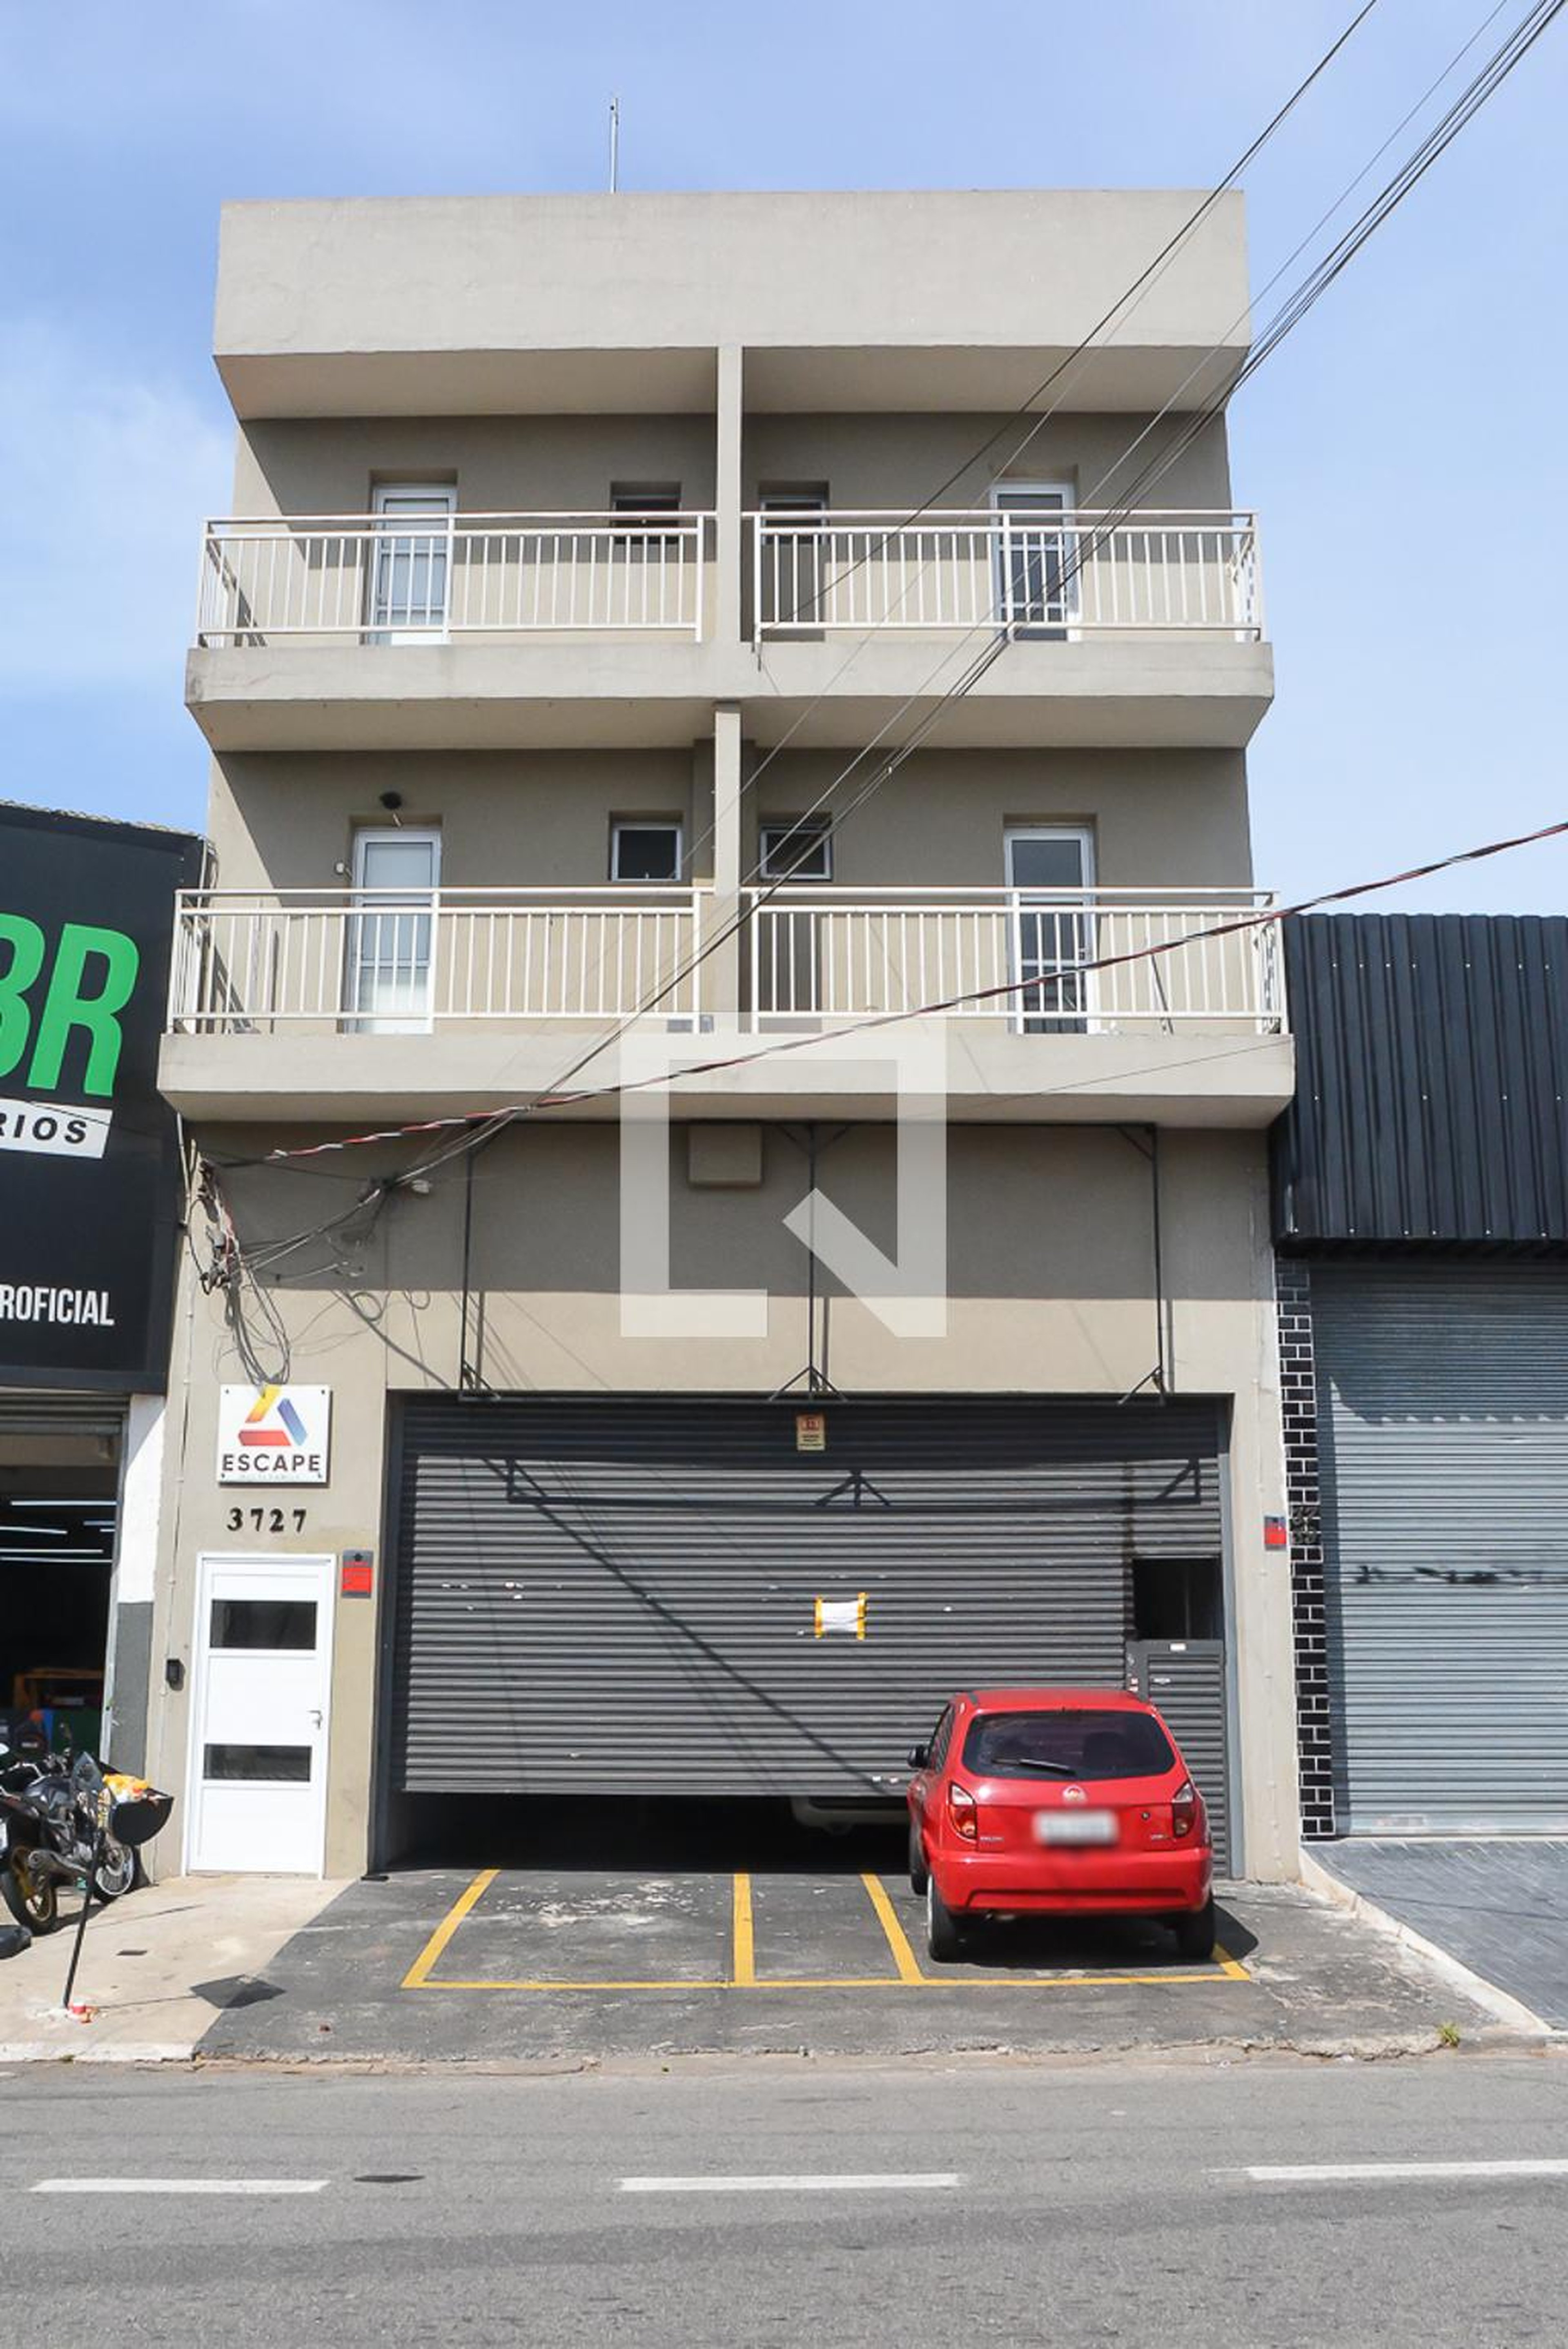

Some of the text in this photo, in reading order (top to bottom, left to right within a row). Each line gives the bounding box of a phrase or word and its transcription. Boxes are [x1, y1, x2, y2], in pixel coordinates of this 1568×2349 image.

[0, 1113, 87, 1143] IOS
[0, 1284, 115, 1325] ROFICIAL
[222, 1454, 321, 1471] ESCAPE
[227, 1507, 307, 1532] 3727
